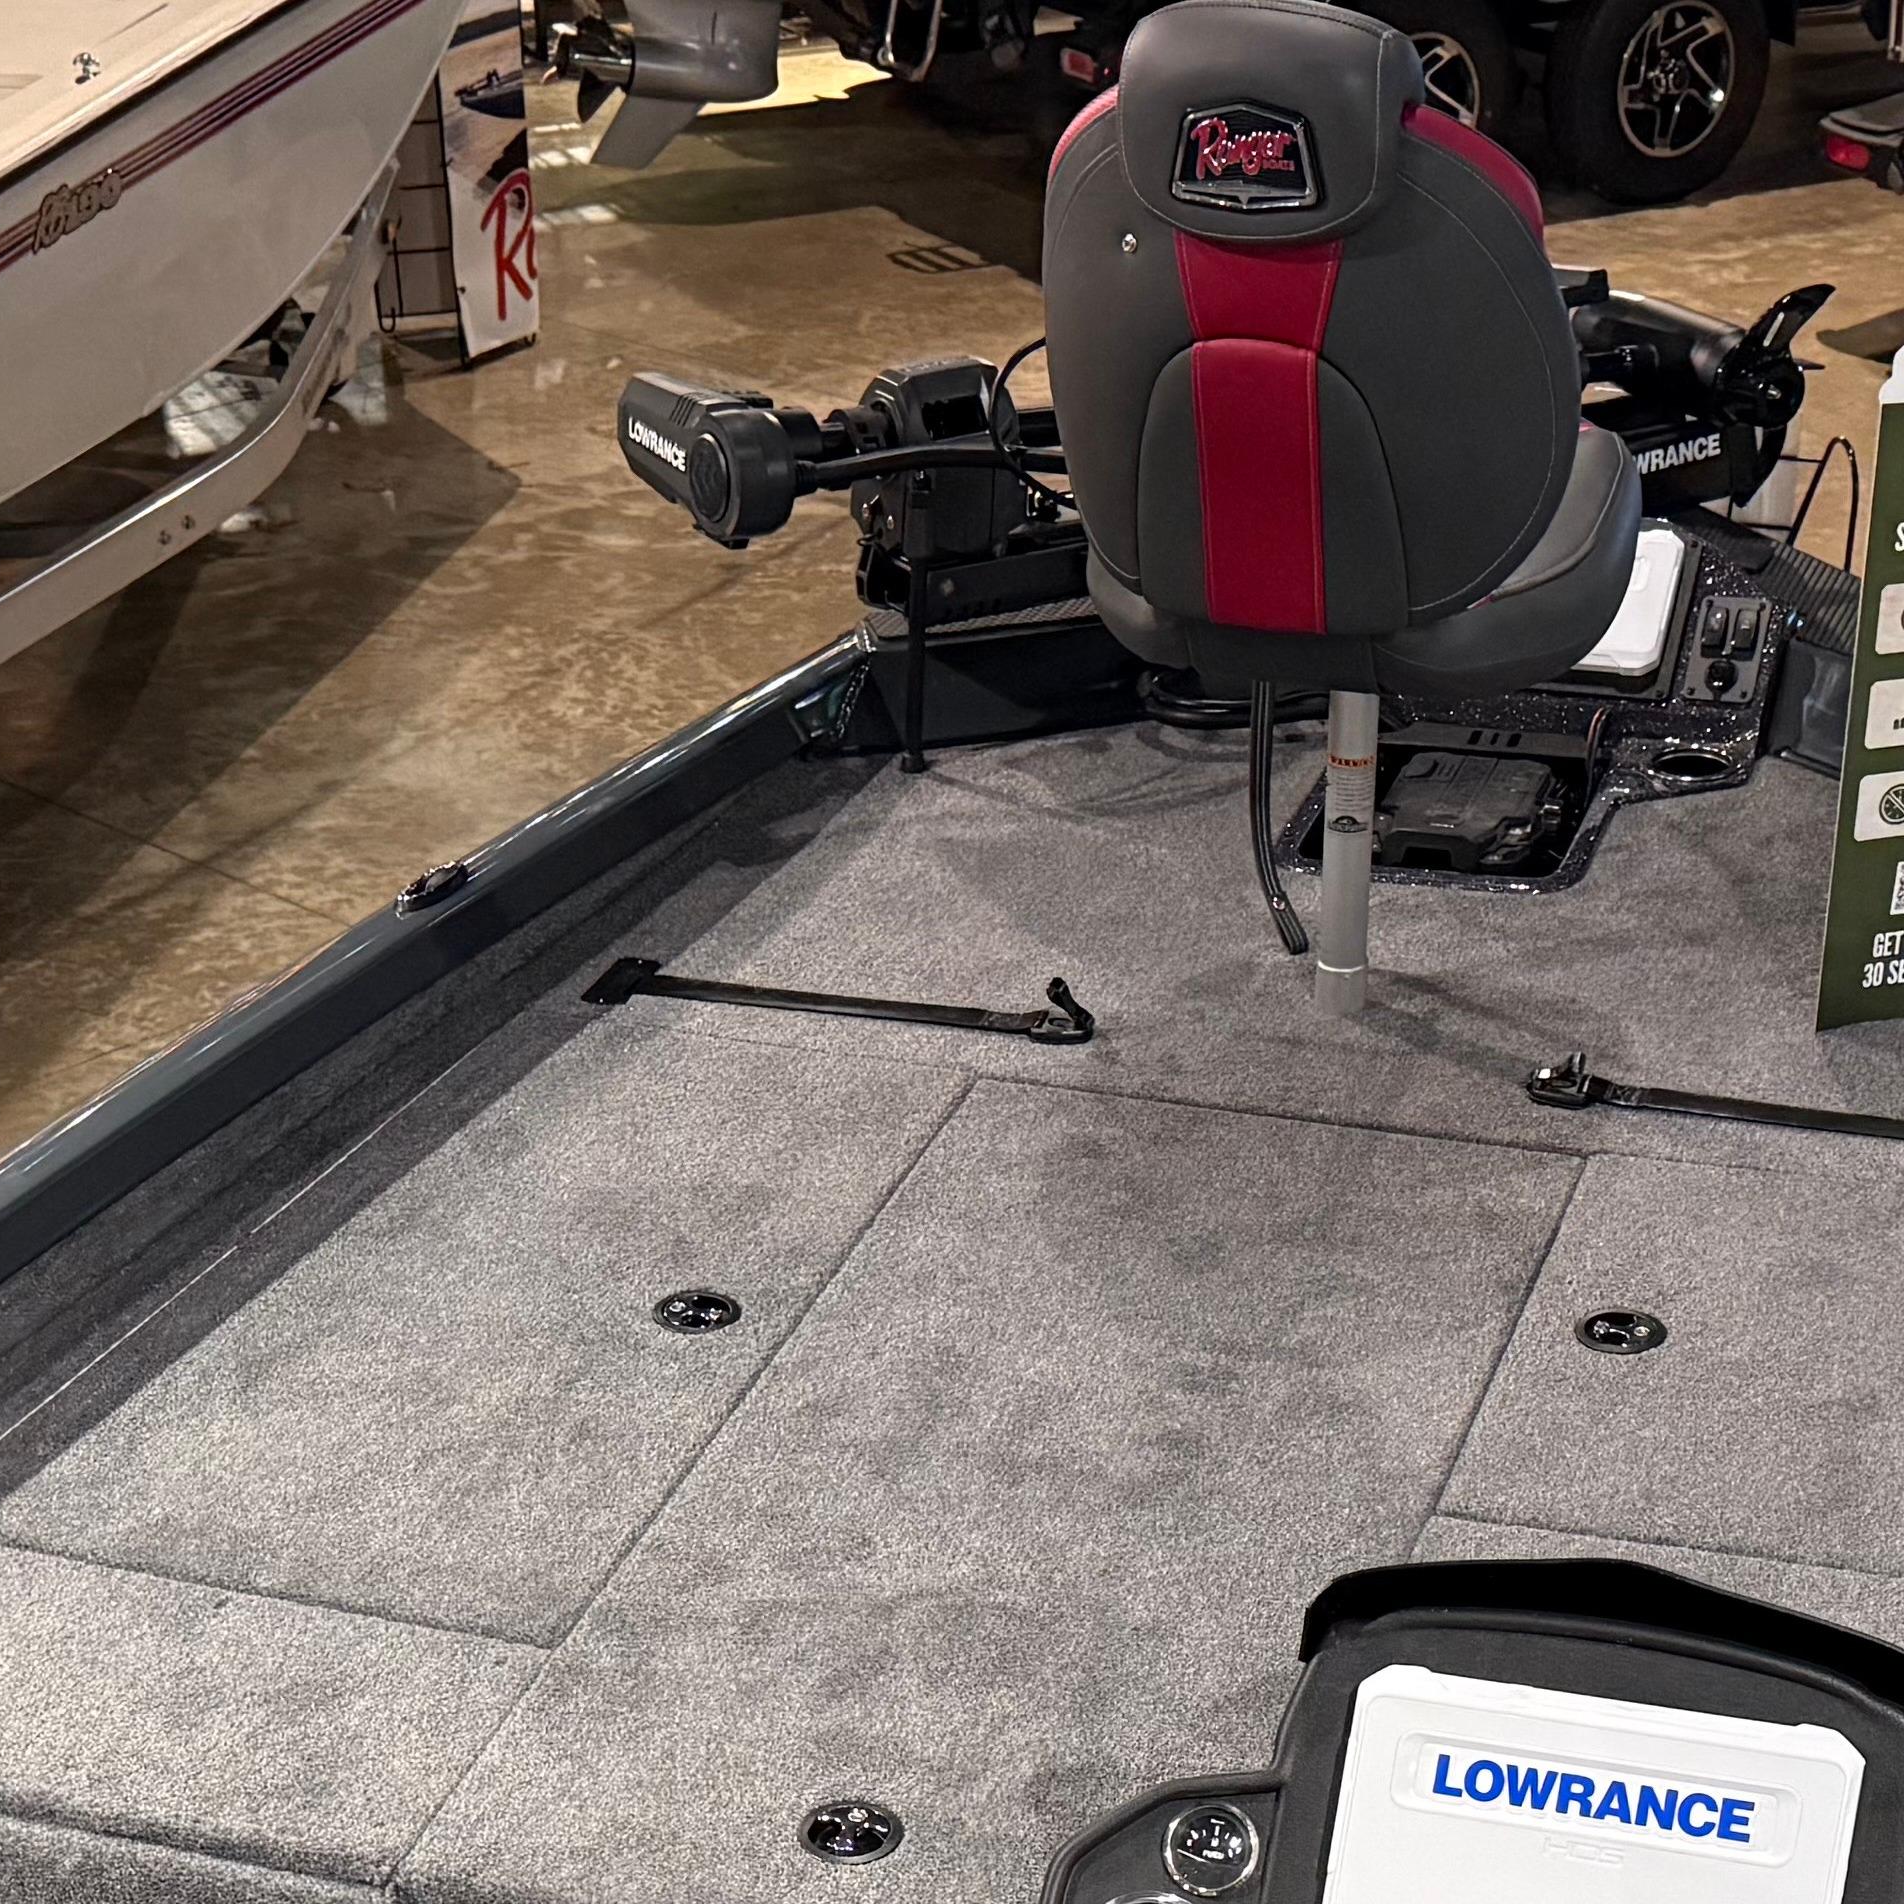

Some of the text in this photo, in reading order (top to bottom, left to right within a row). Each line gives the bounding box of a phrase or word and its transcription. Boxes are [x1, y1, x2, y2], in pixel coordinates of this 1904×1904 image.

[1191, 117, 1296, 180] Ranger
[628, 417, 686, 471] LOWRANCE
[1633, 433, 1721, 474] WRANCE
[1872, 930, 1904, 958] GET
[1862, 961, 1883, 988] 30
[1432, 1754, 1756, 1843] LOWRANCE
